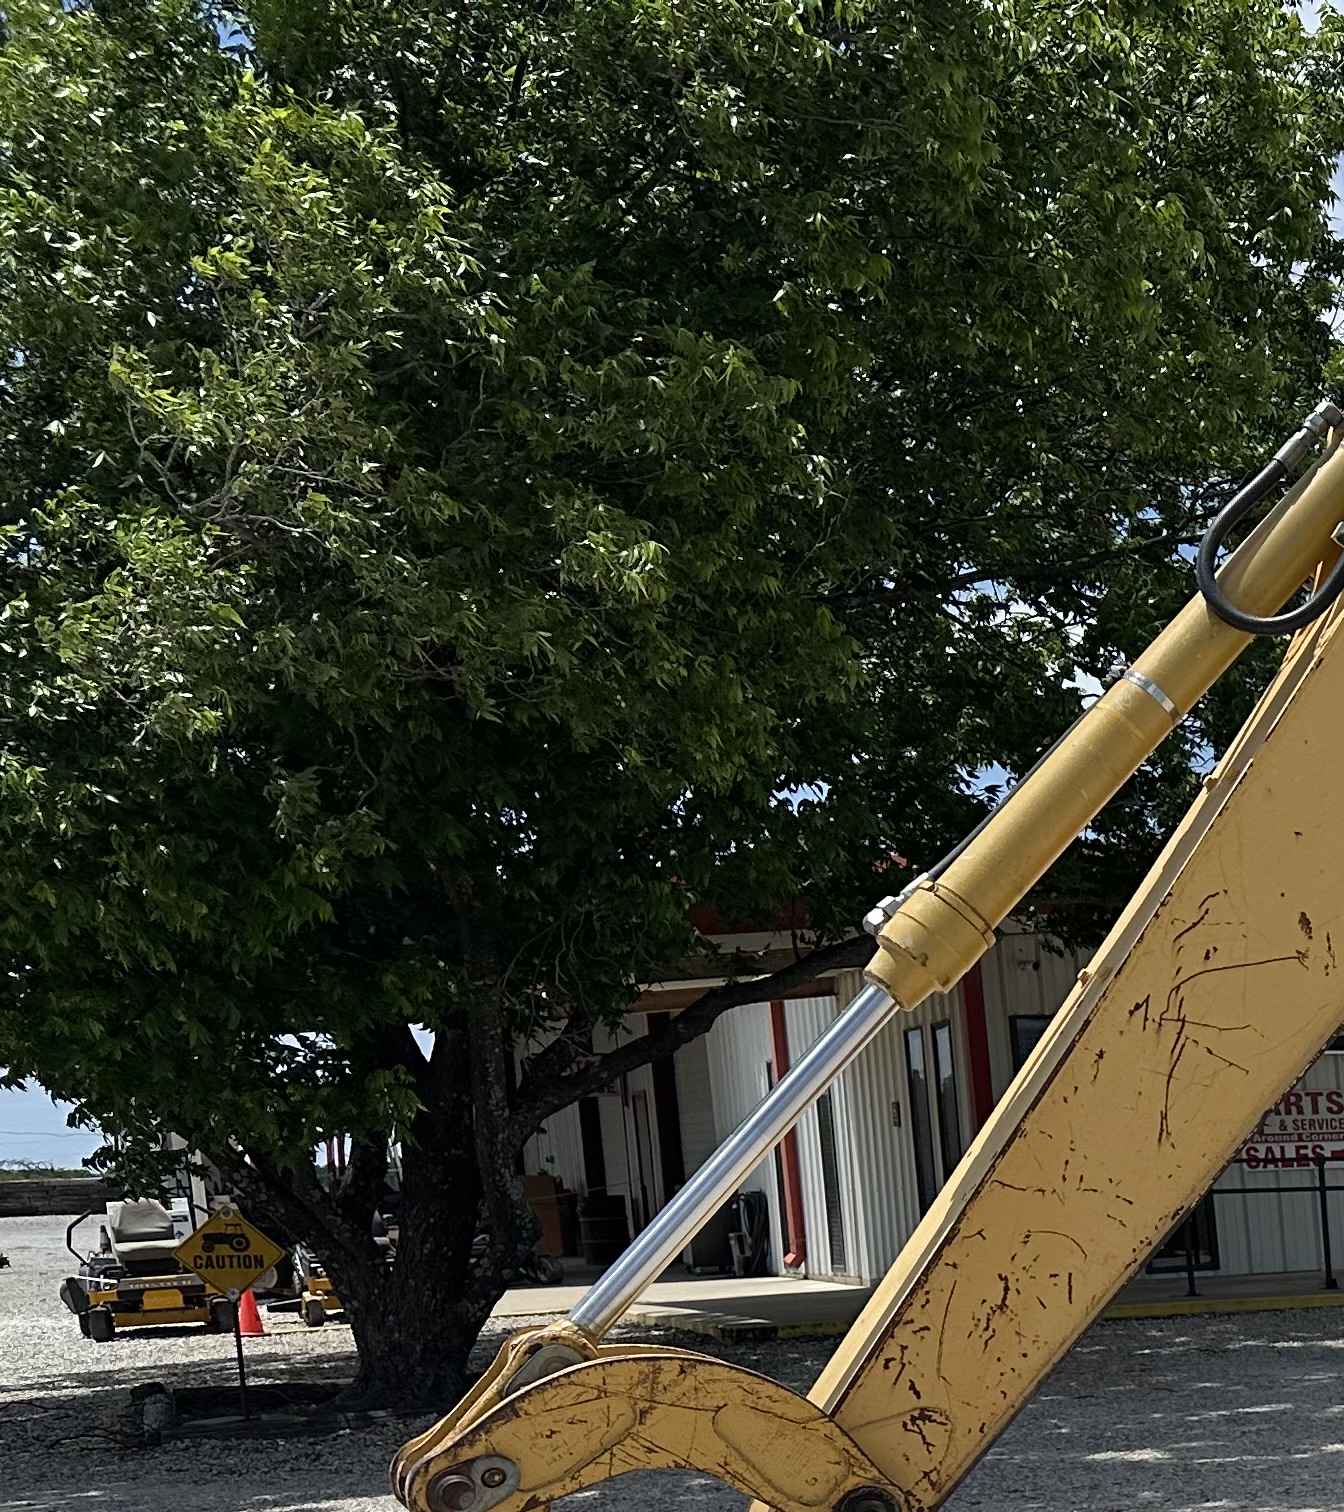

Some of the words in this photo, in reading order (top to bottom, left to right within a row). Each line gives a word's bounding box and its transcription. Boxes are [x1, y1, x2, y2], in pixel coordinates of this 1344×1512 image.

[1274, 1090, 1344, 1116] RTS
[1279, 1119, 1289, 1132] &
[1253, 1133, 1299, 1143] Around
[1302, 1131, 1344, 1141] Corner
[1245, 1143, 1326, 1170] SALES
[193, 1254, 265, 1270] CAUTION
